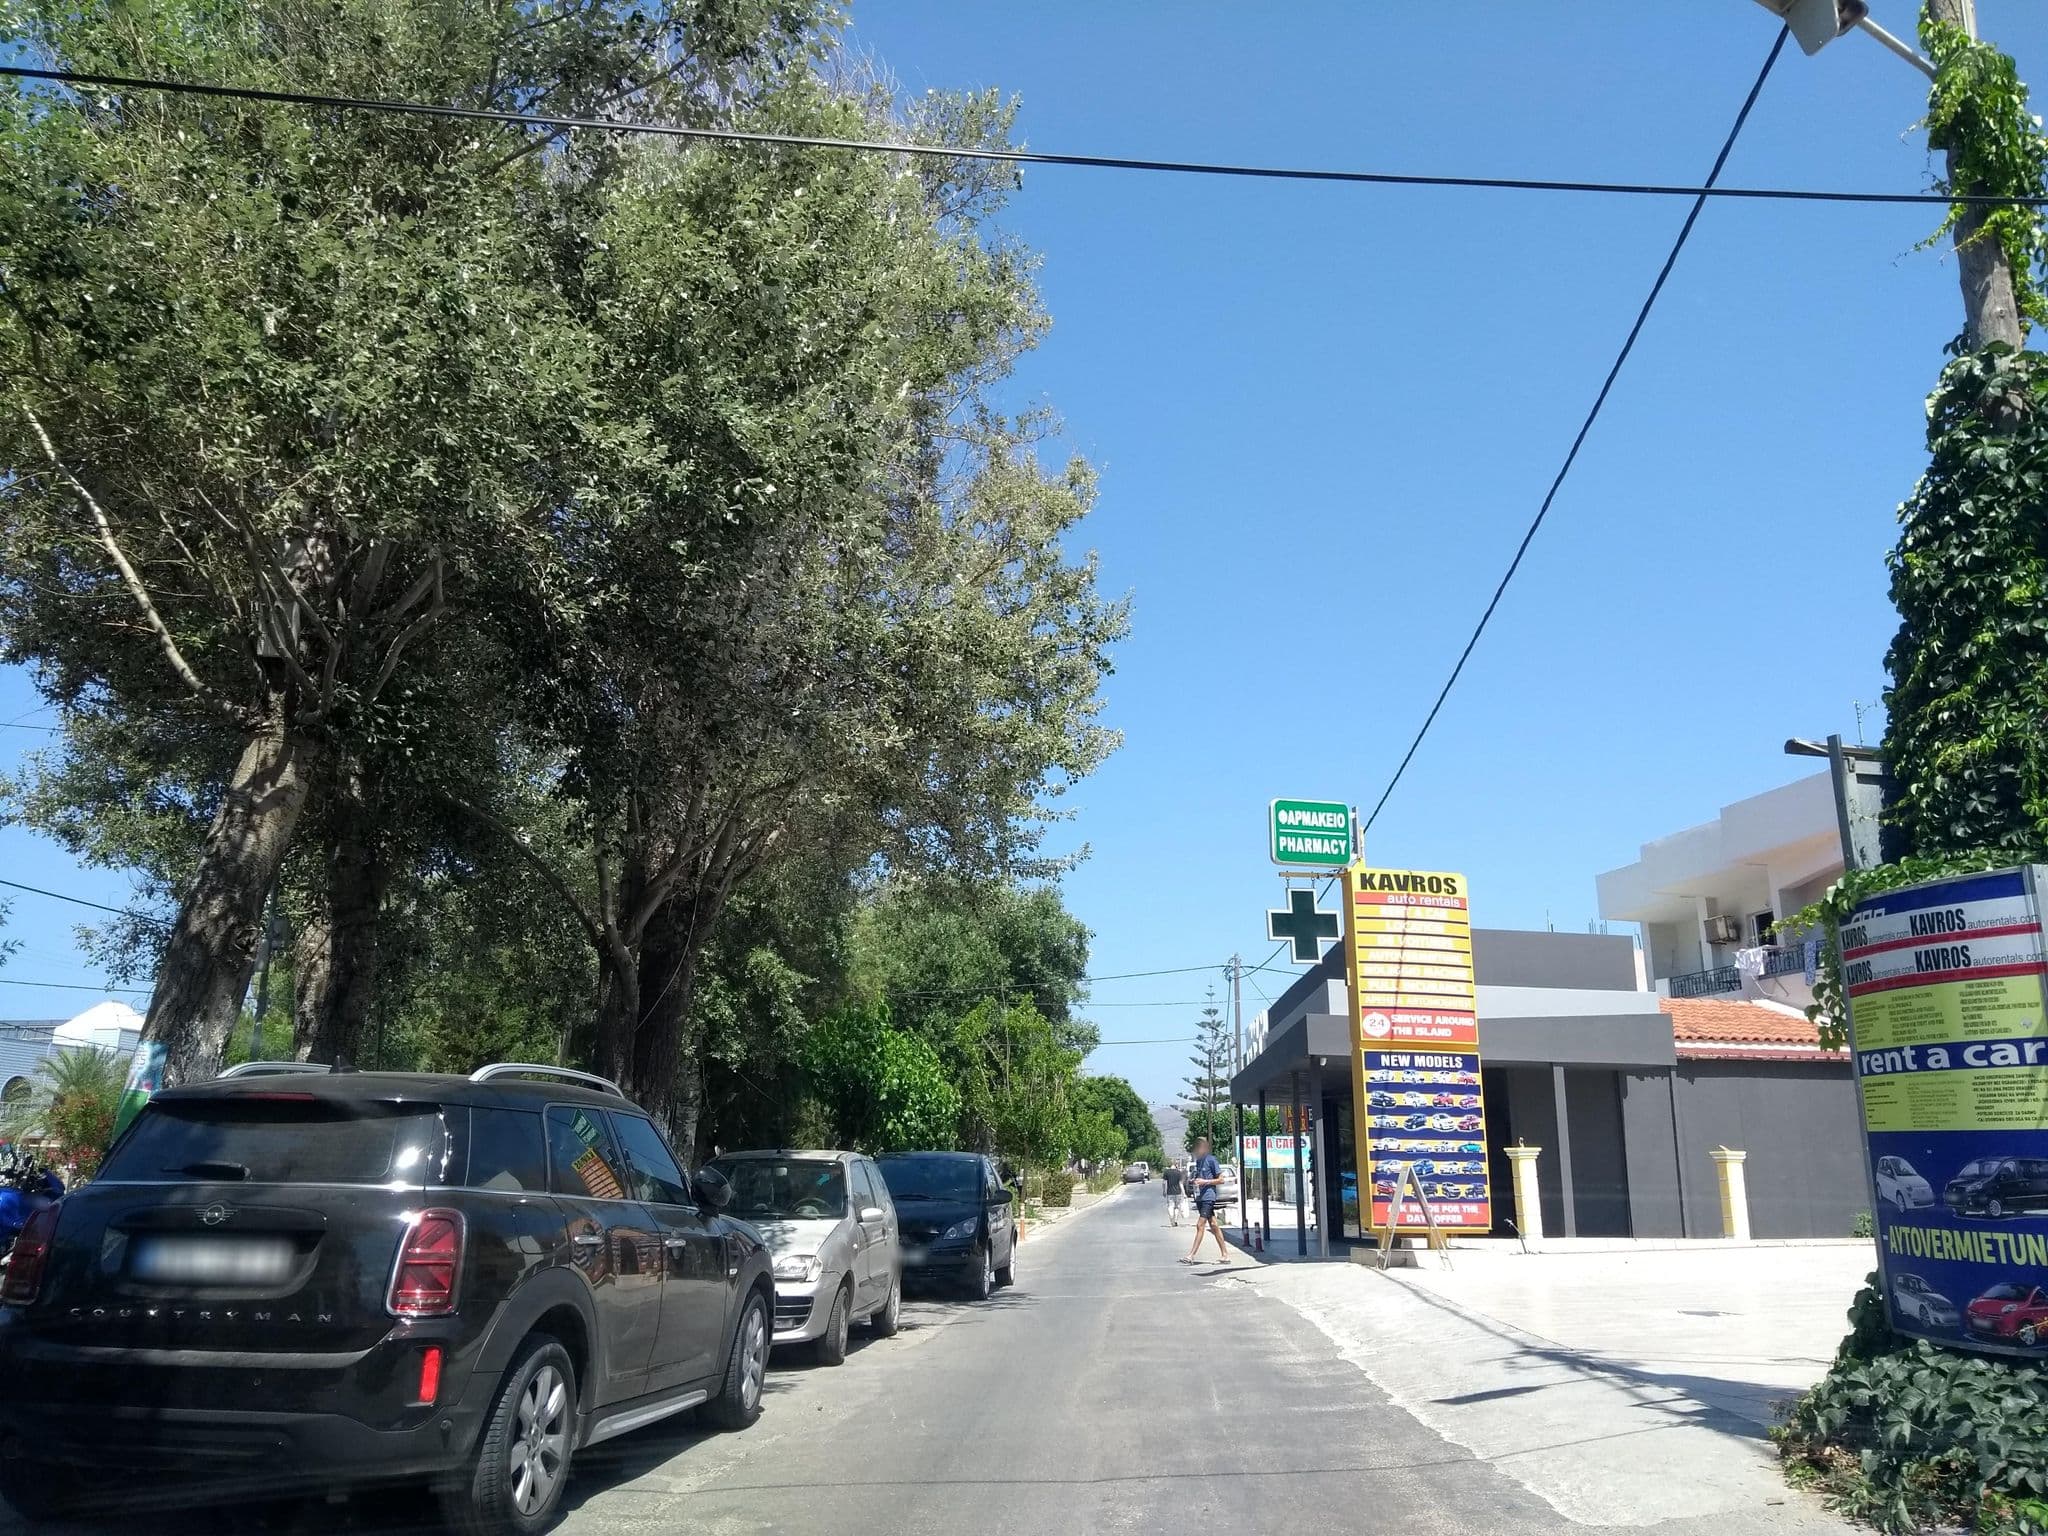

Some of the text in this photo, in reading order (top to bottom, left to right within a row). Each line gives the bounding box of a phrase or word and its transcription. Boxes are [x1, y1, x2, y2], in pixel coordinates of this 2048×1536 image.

[1278, 809, 1346, 829] ΦΑΡΜΑΚΕΙΟ
[1279, 836, 1347, 856] PHARMACY
[1359, 872, 1457, 895] KAVROS
[1387, 894, 1460, 908] auto rentals
[1841, 925, 1868, 951] KAVROS
[1908, 908, 1966, 937] KAVROS
[1845, 960, 1872, 985] KAVROS
[1914, 945, 1972, 973] KAVROS
[1391, 1014, 1432, 1024] SERVICE
[1435, 1016, 1474, 1026] AROUND
[1392, 1027, 1452, 1037] THE ISLAND
[1381, 1054, 1463, 1068] NEW MODELS
[1861, 1041, 2046, 1075] rent a car
[1889, 1225, 2048, 1267] AYTOVERMIETUN
[70, 1306, 333, 1323] COUNTRYMAN
